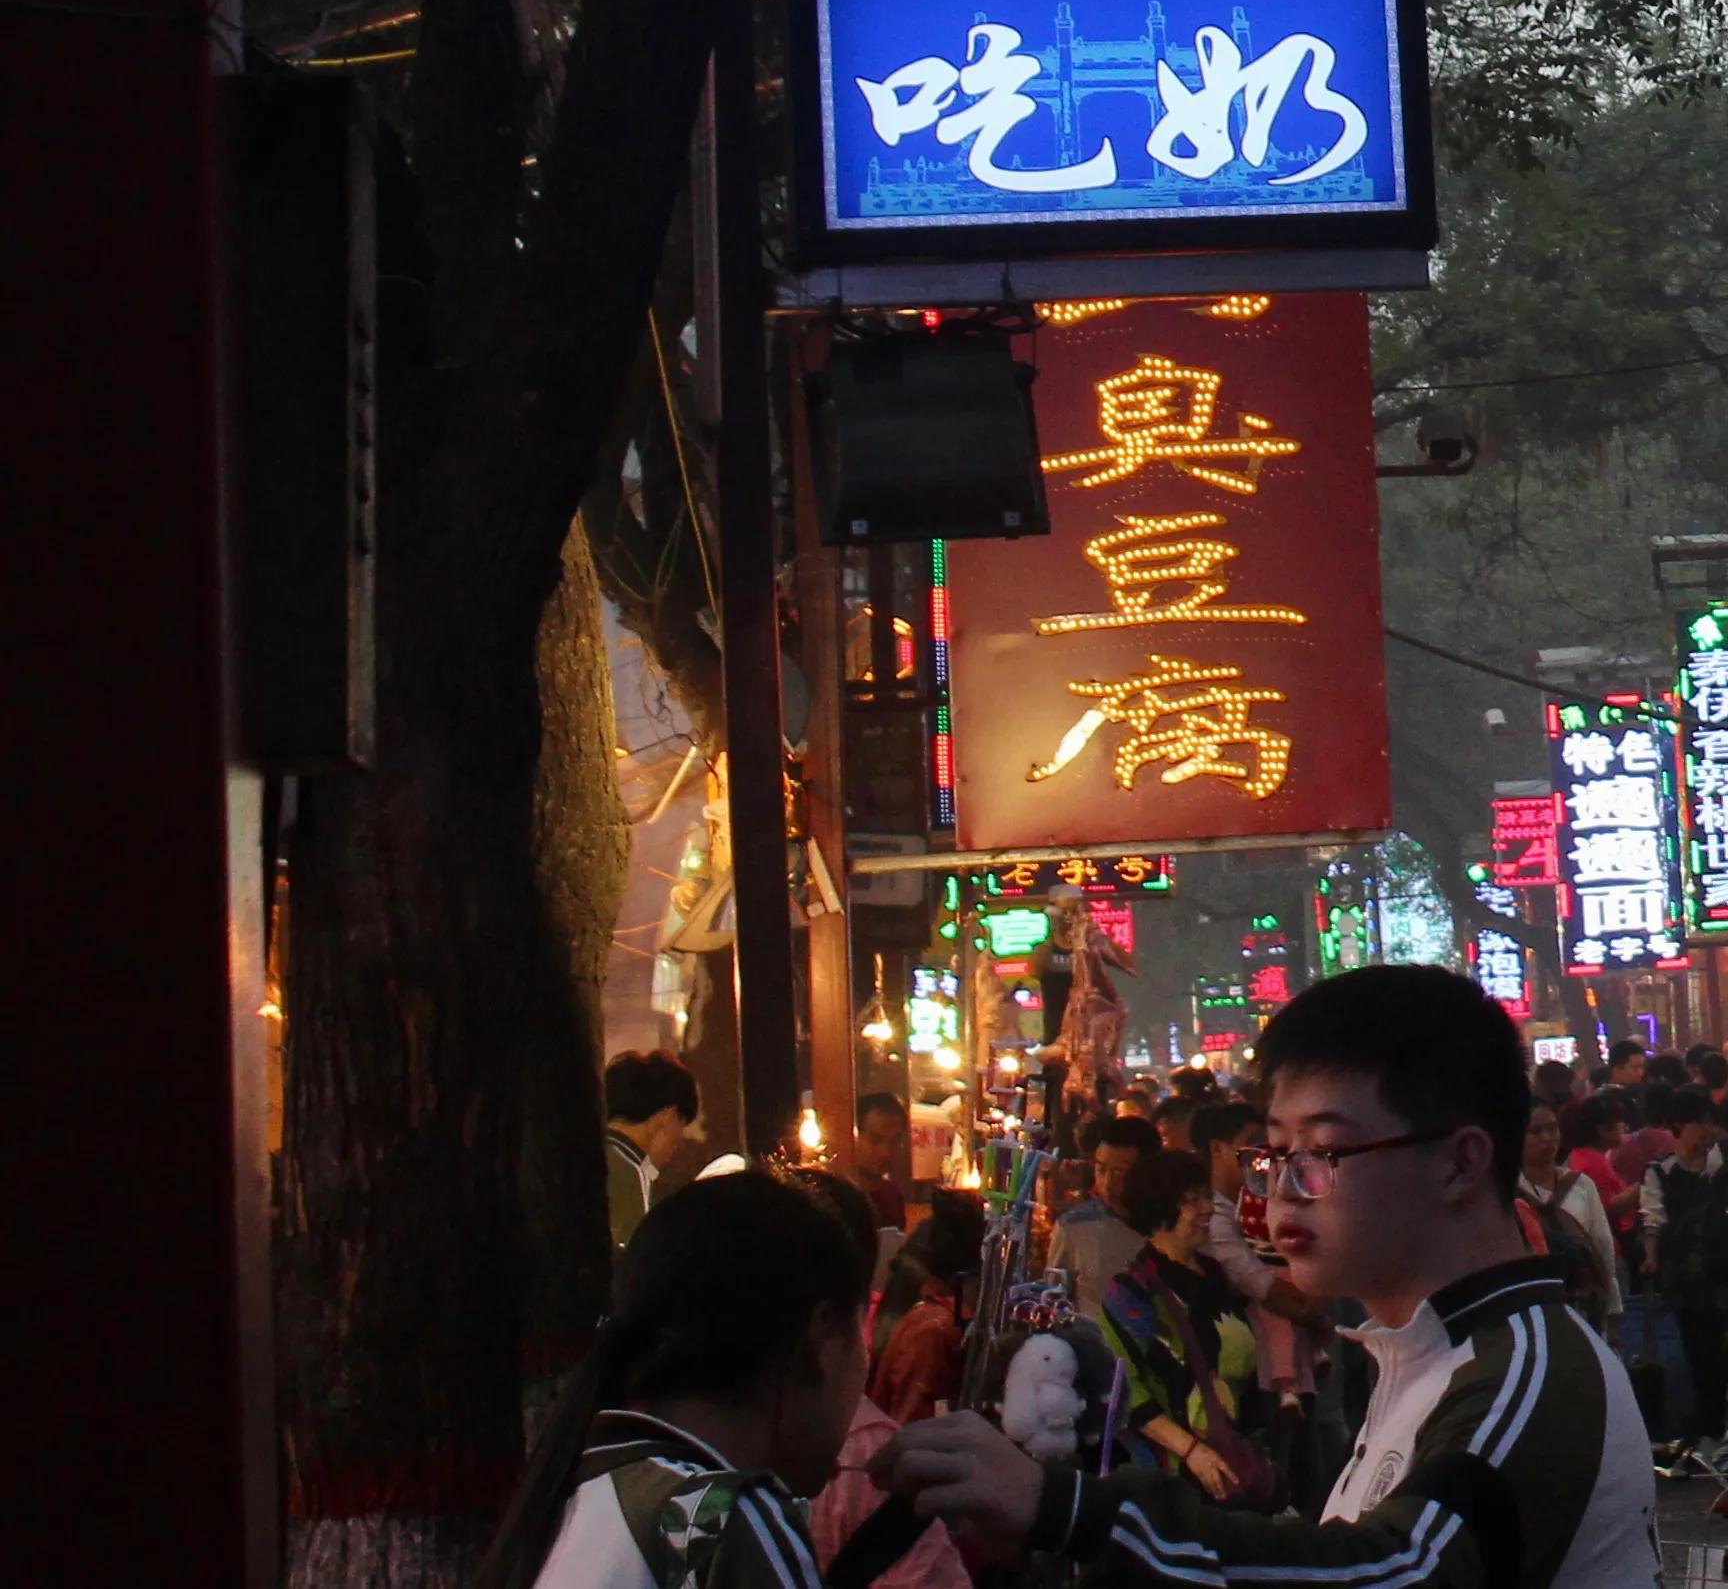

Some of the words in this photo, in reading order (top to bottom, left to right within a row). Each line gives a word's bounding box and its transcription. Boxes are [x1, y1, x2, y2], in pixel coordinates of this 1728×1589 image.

[1026, 296, 1308, 801] 臭豆腐
[1561, 730, 1660, 776] 特色
[1572, 935, 1681, 965] 老字号
